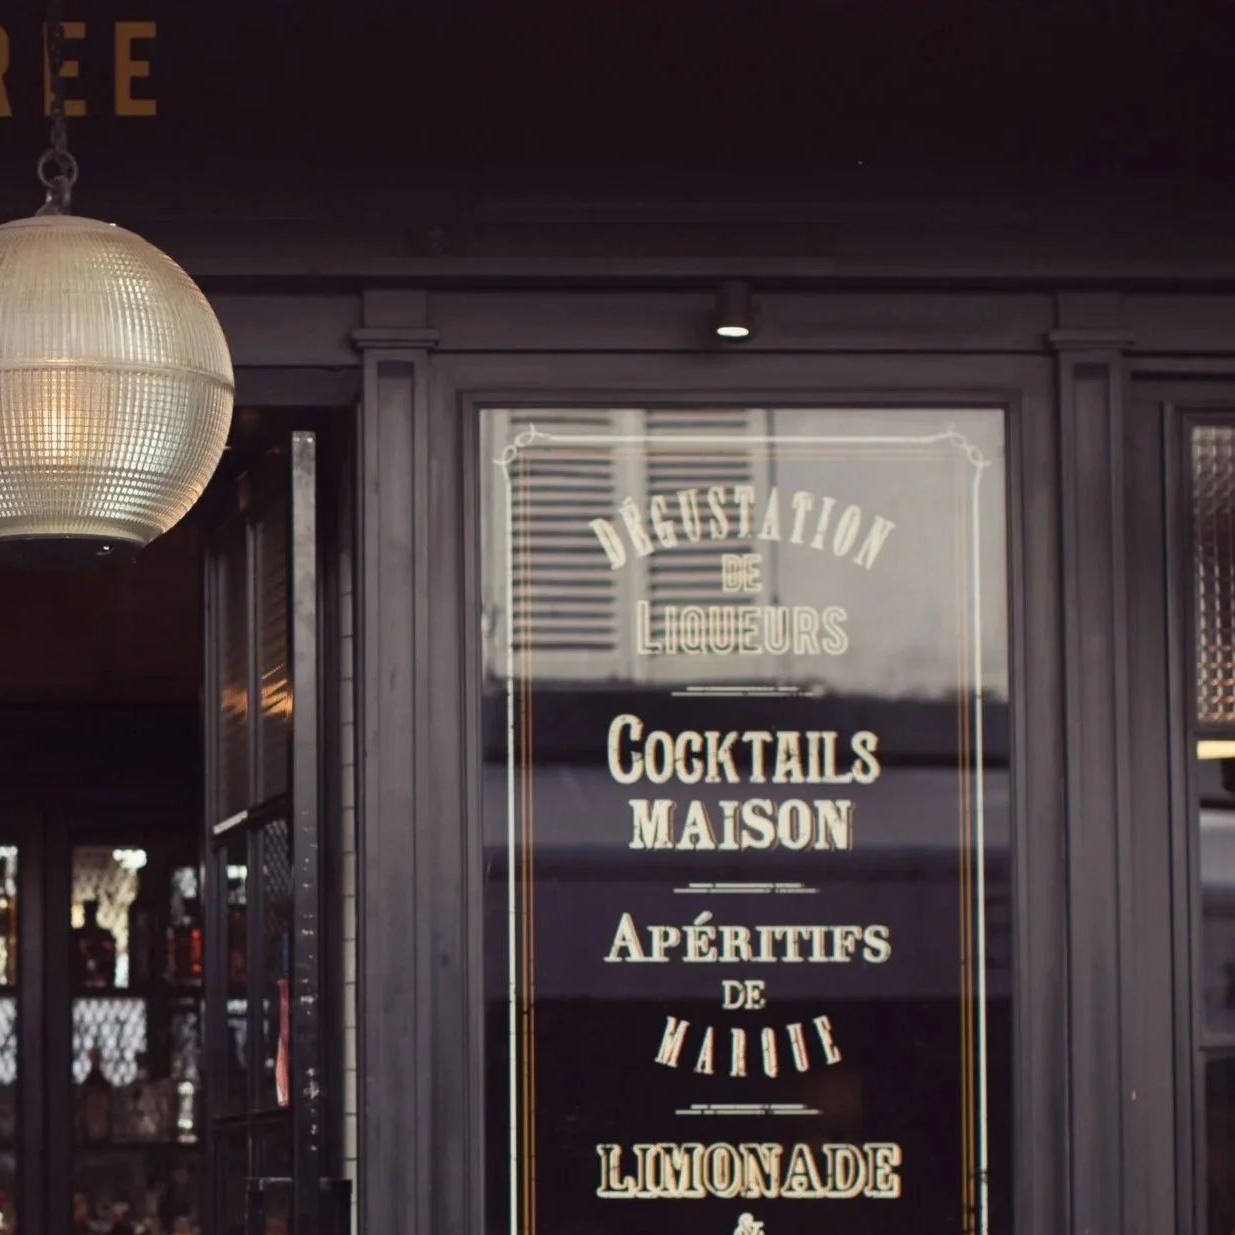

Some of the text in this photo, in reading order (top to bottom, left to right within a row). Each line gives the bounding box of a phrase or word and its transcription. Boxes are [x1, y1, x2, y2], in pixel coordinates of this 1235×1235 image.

[588, 485, 897, 571] DÉGUSTATION
[721, 553, 764, 592] DE
[636, 600, 849, 656] LIQUEURS
[607, 714, 881, 784] COCKTAILS
[628, 798, 855, 851] MAISON
[603, 911, 892, 964] APÉRITIFS
[722, 980, 767, 1010] DE
[654, 1015, 842, 1079] MARQUE
[596, 1142, 903, 1199] LIMONADE
